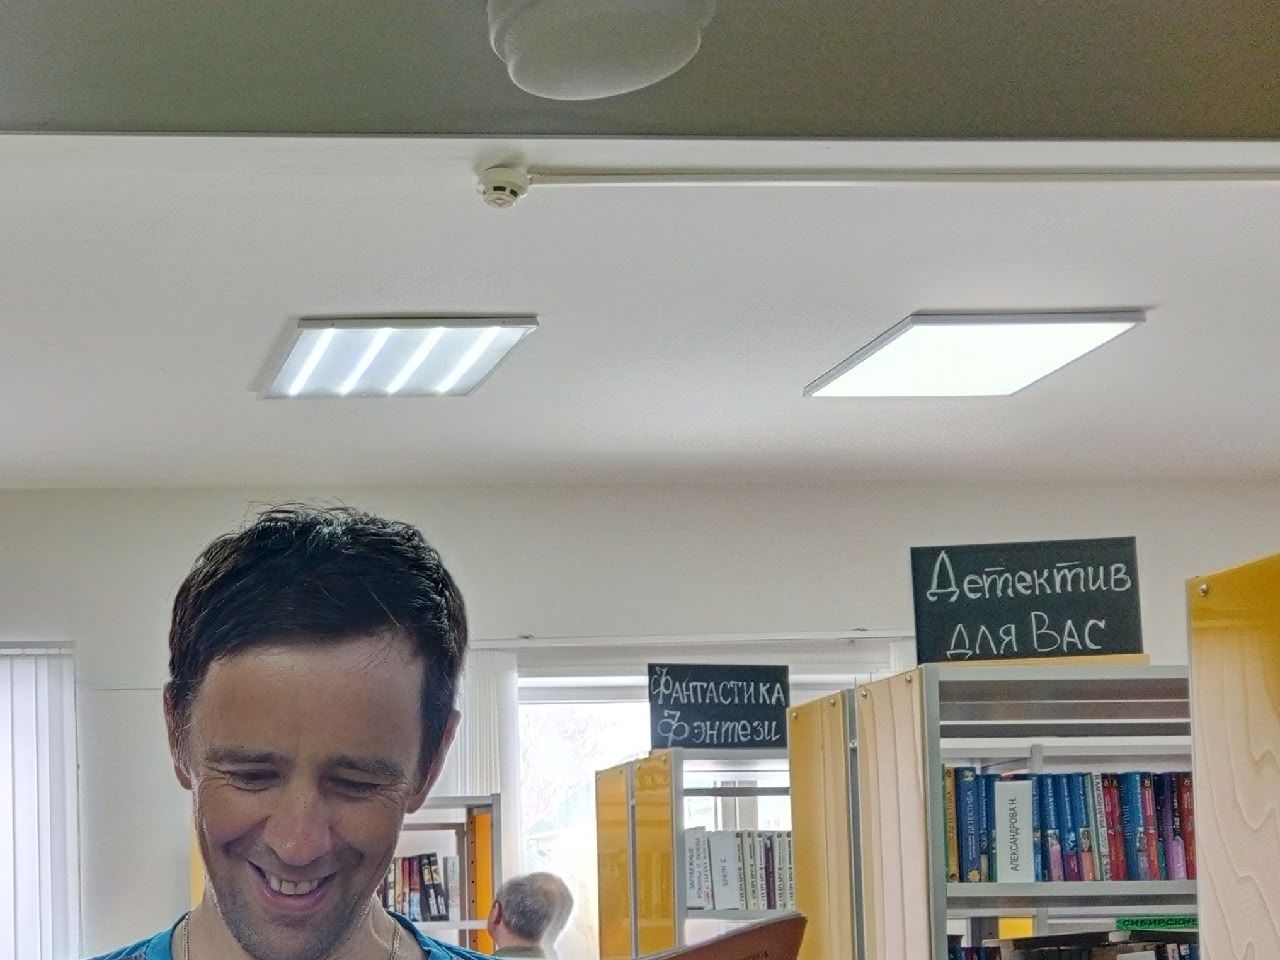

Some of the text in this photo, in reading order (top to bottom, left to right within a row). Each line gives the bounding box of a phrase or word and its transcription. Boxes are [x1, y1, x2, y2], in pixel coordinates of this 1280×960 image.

[926, 550, 1132, 602] Детектив
[657, 709, 781, 747] Фэнтези
[1008, 806, 1020, 872] АЛЕКСАНДРОВА
